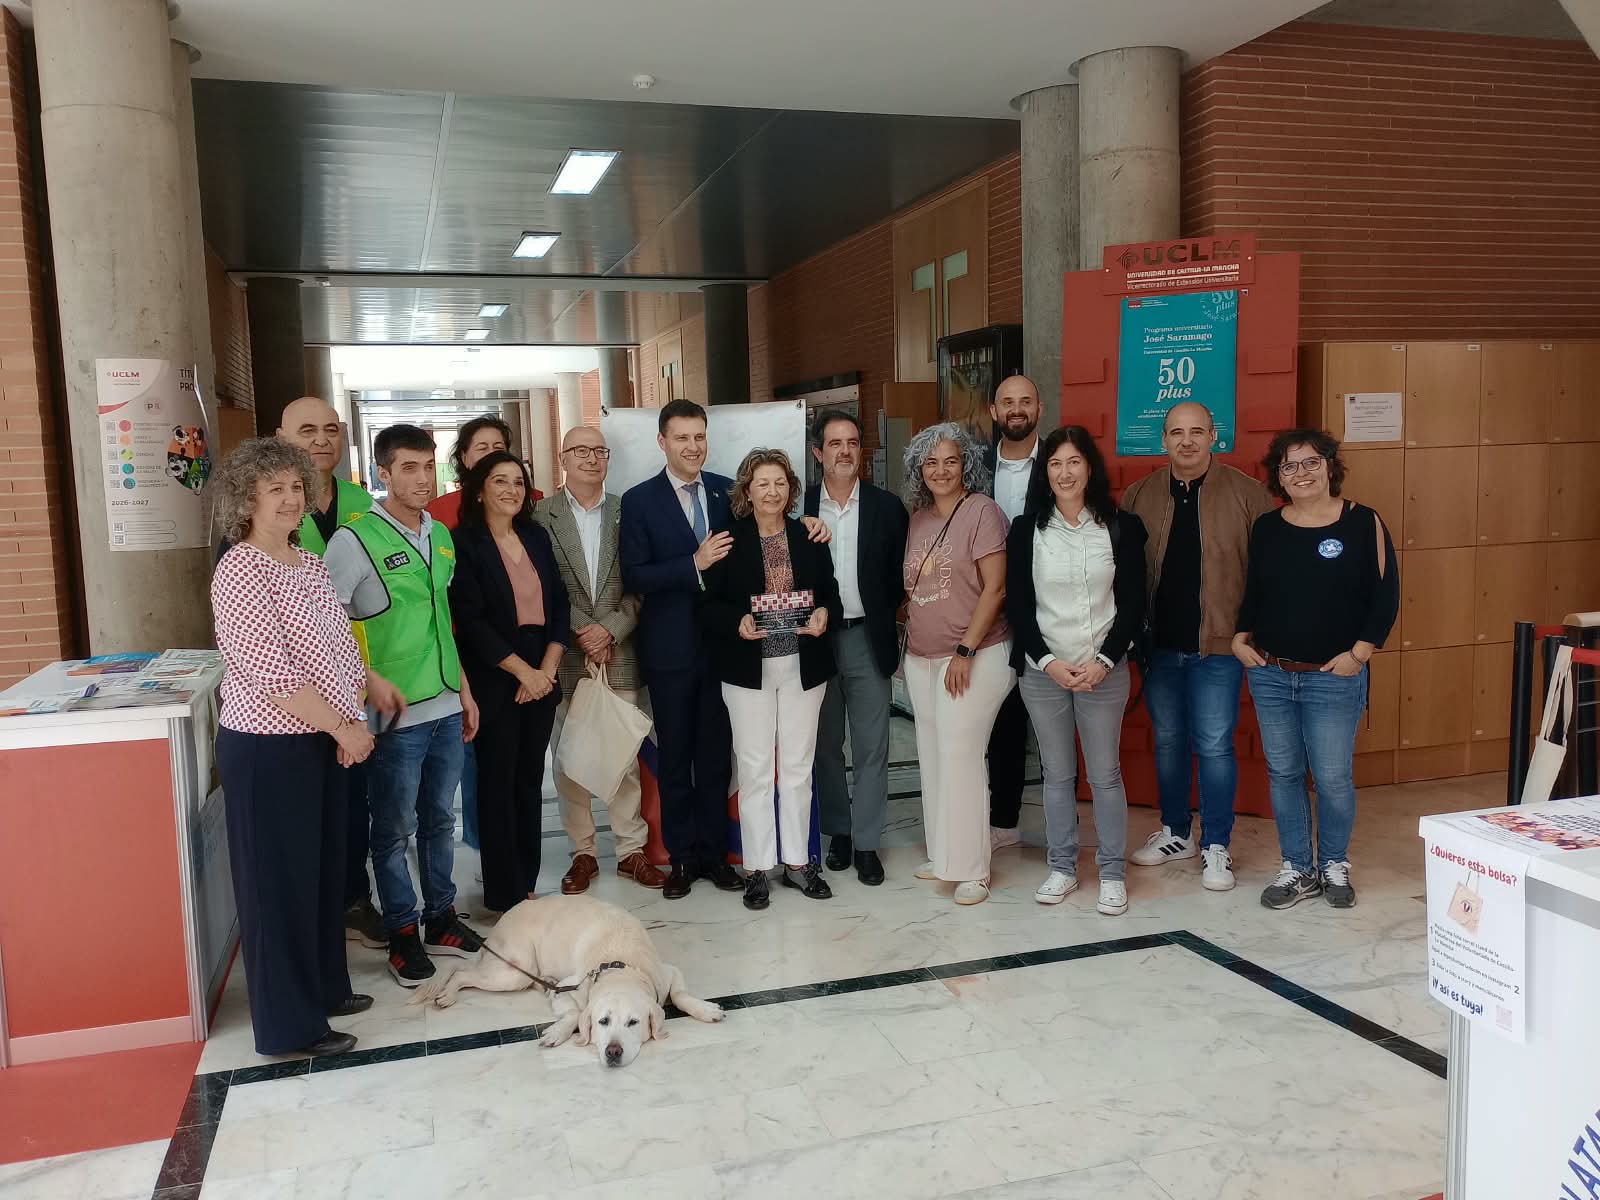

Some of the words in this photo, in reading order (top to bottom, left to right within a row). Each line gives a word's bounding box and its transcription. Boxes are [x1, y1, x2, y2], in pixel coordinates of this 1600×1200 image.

[1143, 240, 1240, 265] UCLM
[1211, 263, 1239, 271] MANCHA
[1174, 324, 1213, 332] universitario
[1143, 335, 1165, 343] José
[1167, 332, 1213, 342] Saramago
[1158, 356, 1195, 385] 50
[1155, 384, 1191, 403] plus
[1430, 843, 1466, 866] ¿Quieres
[1467, 859, 1486, 875] esta
[1488, 865, 1517, 887] bolsa?
[1431, 958, 1436, 966] 3
[1432, 975, 1439, 990] ¡Y
[1450, 990, 1459, 1002] es
[1461, 994, 1484, 1016] tuya!
[1514, 985, 1520, 995] 2
